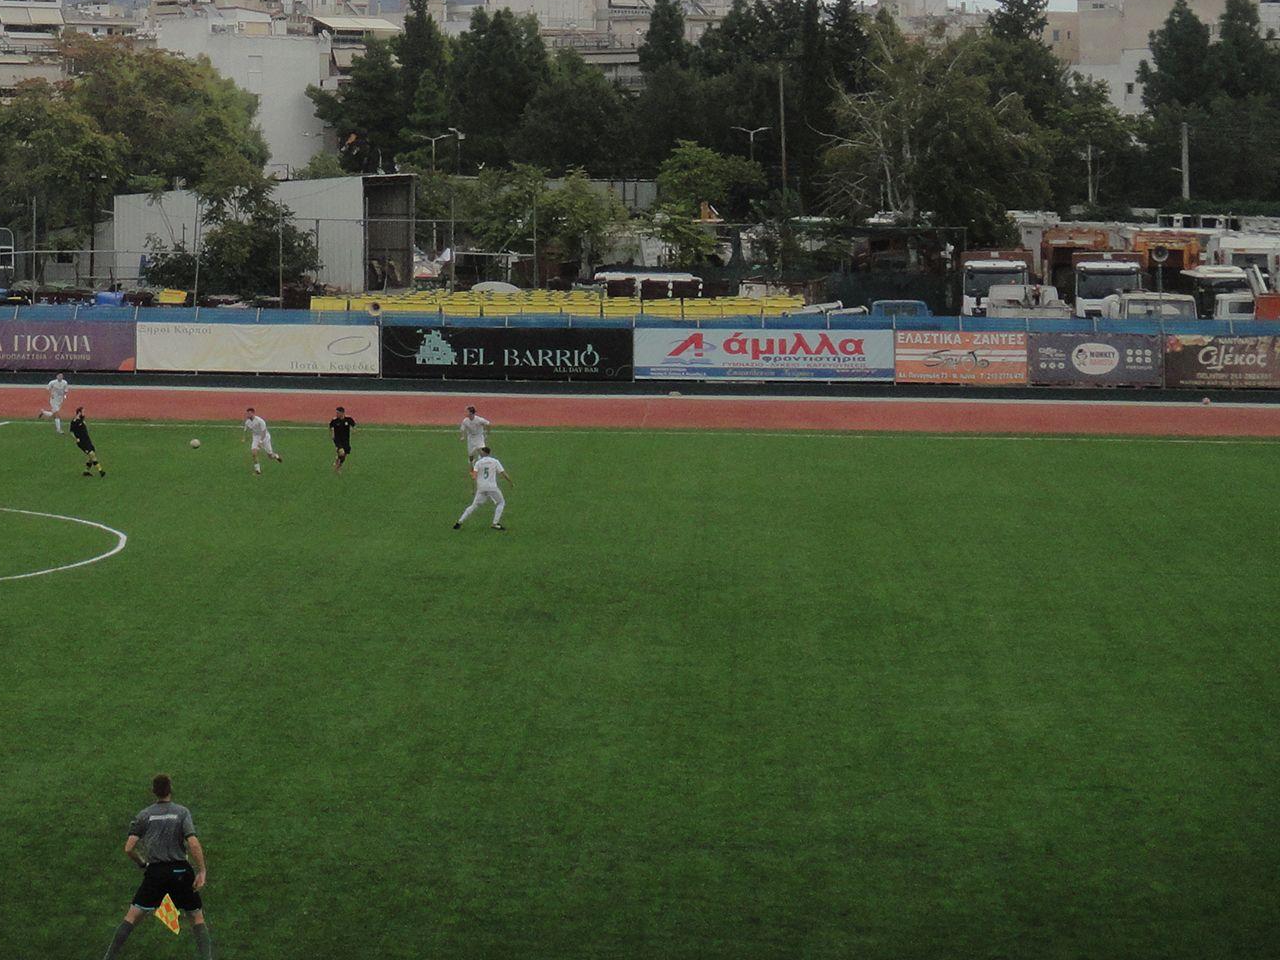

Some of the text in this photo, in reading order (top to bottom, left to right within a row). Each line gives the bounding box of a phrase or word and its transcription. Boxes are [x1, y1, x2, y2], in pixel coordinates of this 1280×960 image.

[14, 334, 92, 352] ΠΟΥΛΙΑ
[722, 332, 865, 361] άμιλλα
[897, 332, 962, 345] ΕΛΑΣΤΙΚΑ
[973, 333, 1025, 345] ΖΑΝΤΕΣ
[463, 348, 495, 366] EL
[762, 355, 866, 363] φροντιστήρια
